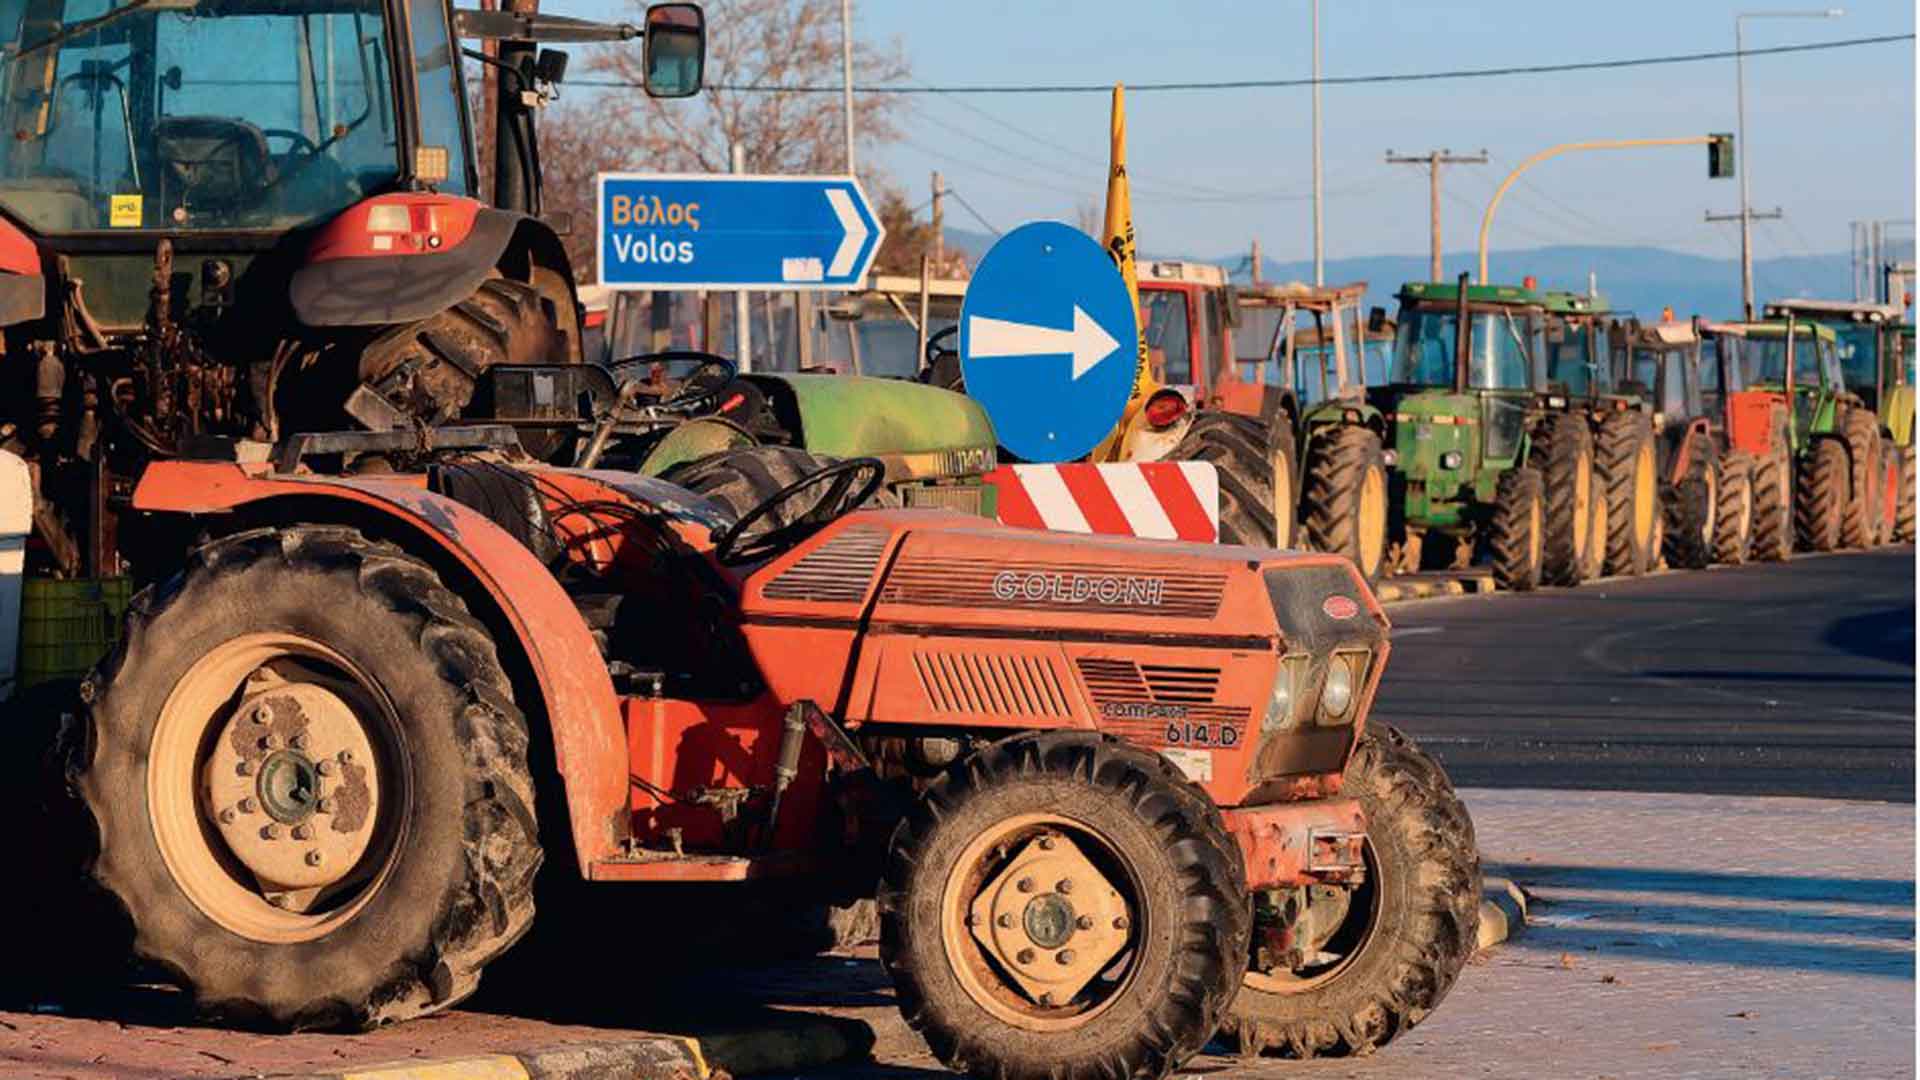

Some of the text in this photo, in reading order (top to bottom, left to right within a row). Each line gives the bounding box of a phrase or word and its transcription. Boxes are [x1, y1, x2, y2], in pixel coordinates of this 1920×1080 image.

[612, 195, 700, 232] Βόλος
[612, 234, 694, 263] Volos
[994, 571, 1163, 605] GOLDONI
